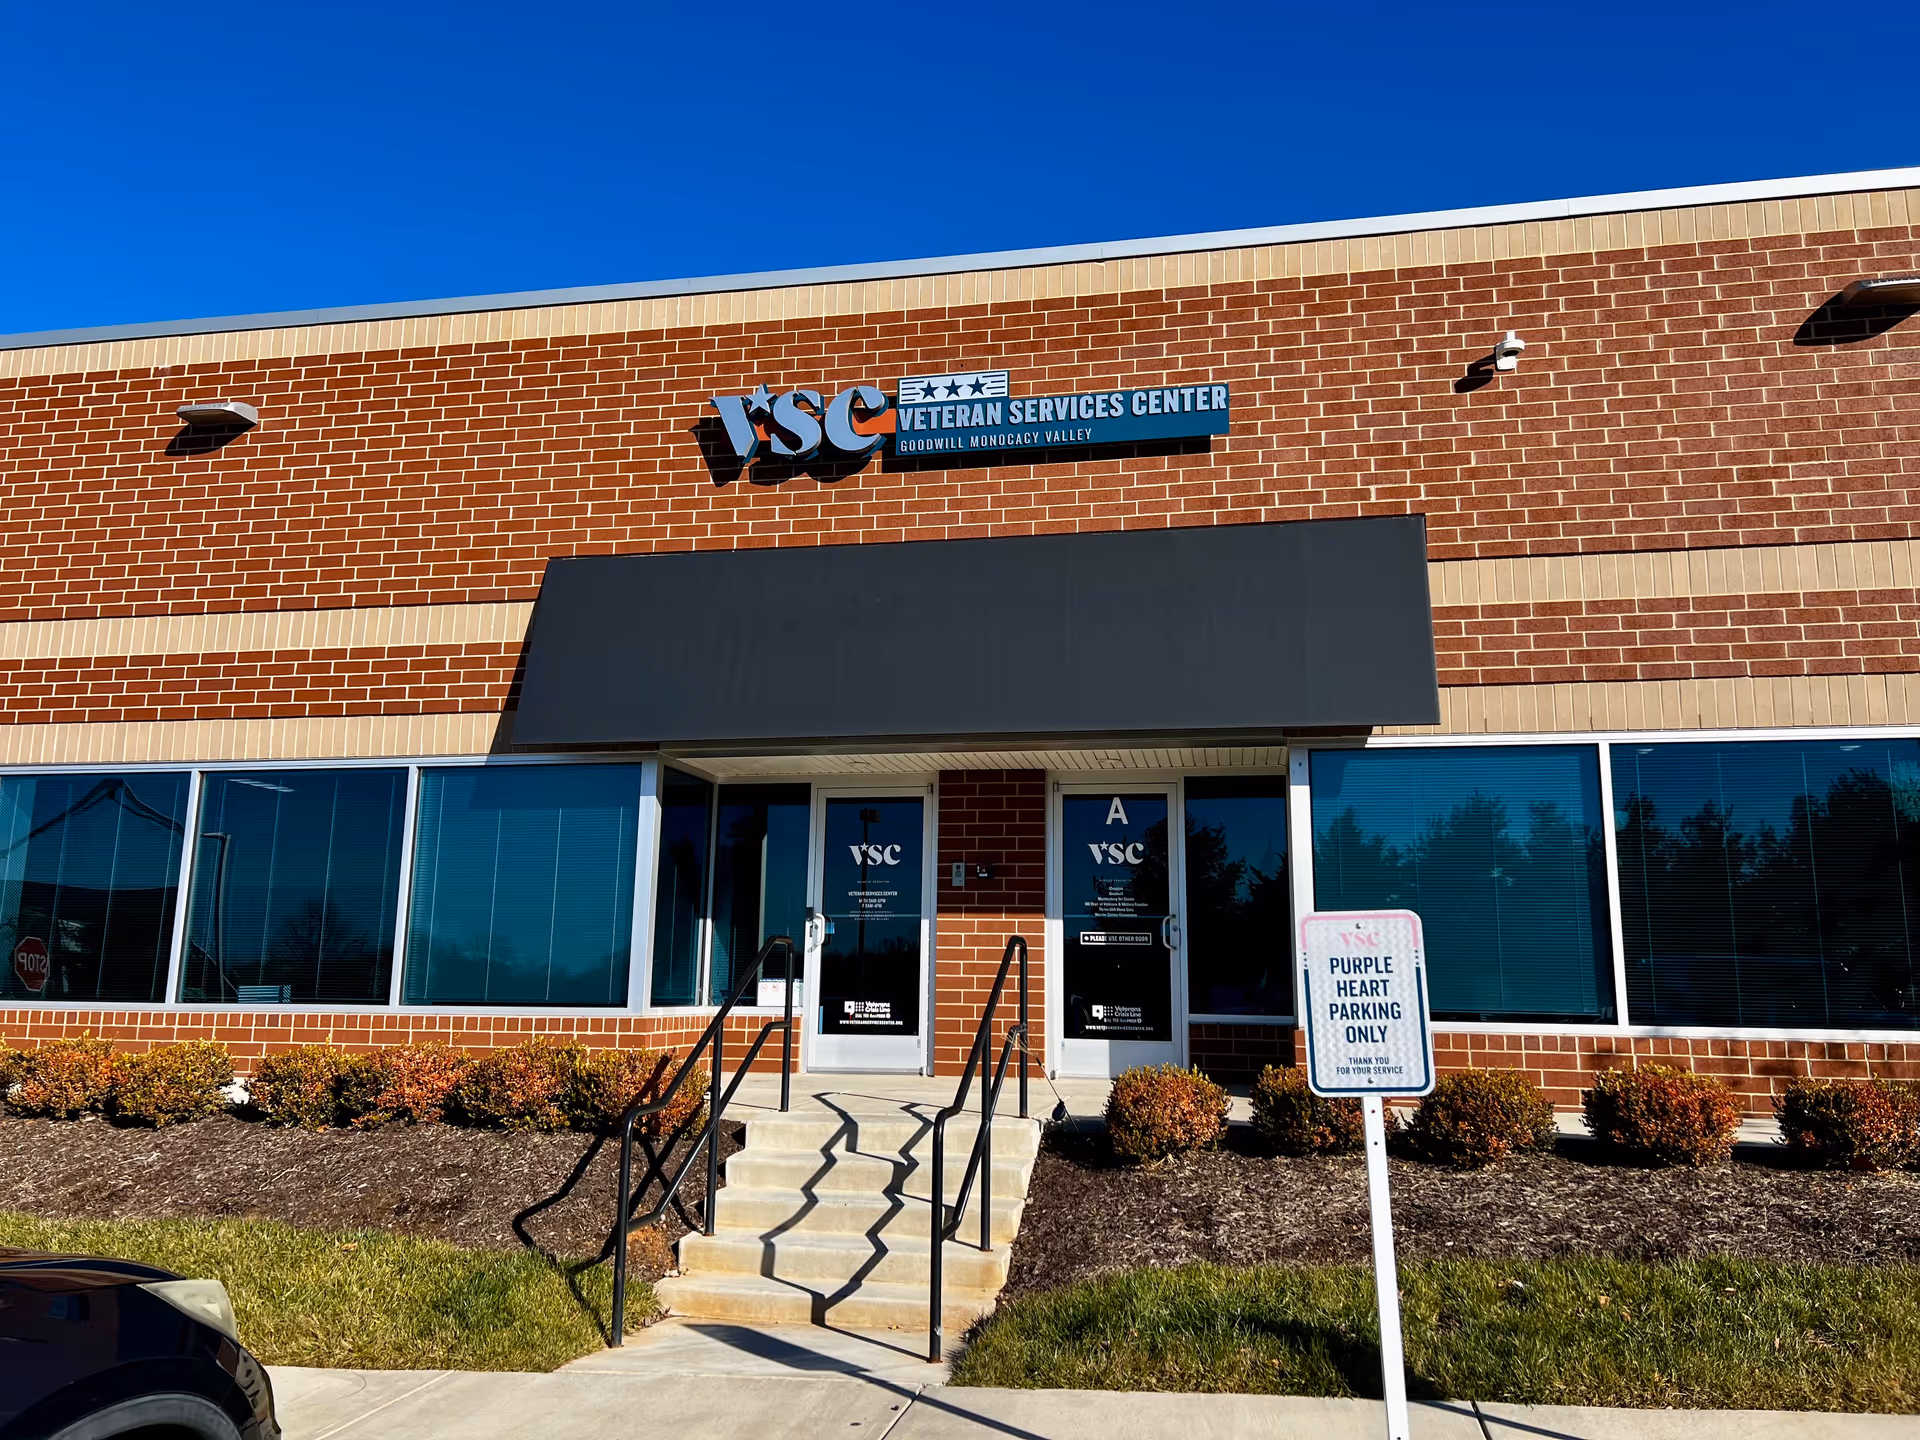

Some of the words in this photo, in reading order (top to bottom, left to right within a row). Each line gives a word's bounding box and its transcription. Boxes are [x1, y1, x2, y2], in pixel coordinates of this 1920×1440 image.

[899, 402, 1001, 431] VETERAN
[1009, 393, 1124, 424] SERVICES
[1132, 385, 1227, 416] CENTER
[709, 382, 886, 463] VSC
[900, 437, 964, 452] GOODWILL
[970, 431, 1039, 448] MONOCACY
[1044, 428, 1091, 443] VALLEY
[1106, 797, 1129, 824] A
[848, 842, 901, 866] VSC
[1087, 840, 1144, 865] VSC
[1340, 932, 1381, 947] VSC
[1329, 956, 1394, 975] PURPLE
[1336, 979, 1390, 997] HEART
[1329, 1002, 1402, 1021] PARKING
[1345, 1025, 1388, 1043] ONLY
[1336, 1066, 1351, 1075] FOR
[1352, 1066, 1372, 1075] YOUR
[1373, 1065, 1404, 1075] SERVICE
[1348, 1057, 1373, 1065] THANK
[1374, 1056, 1390, 1065] YOU
